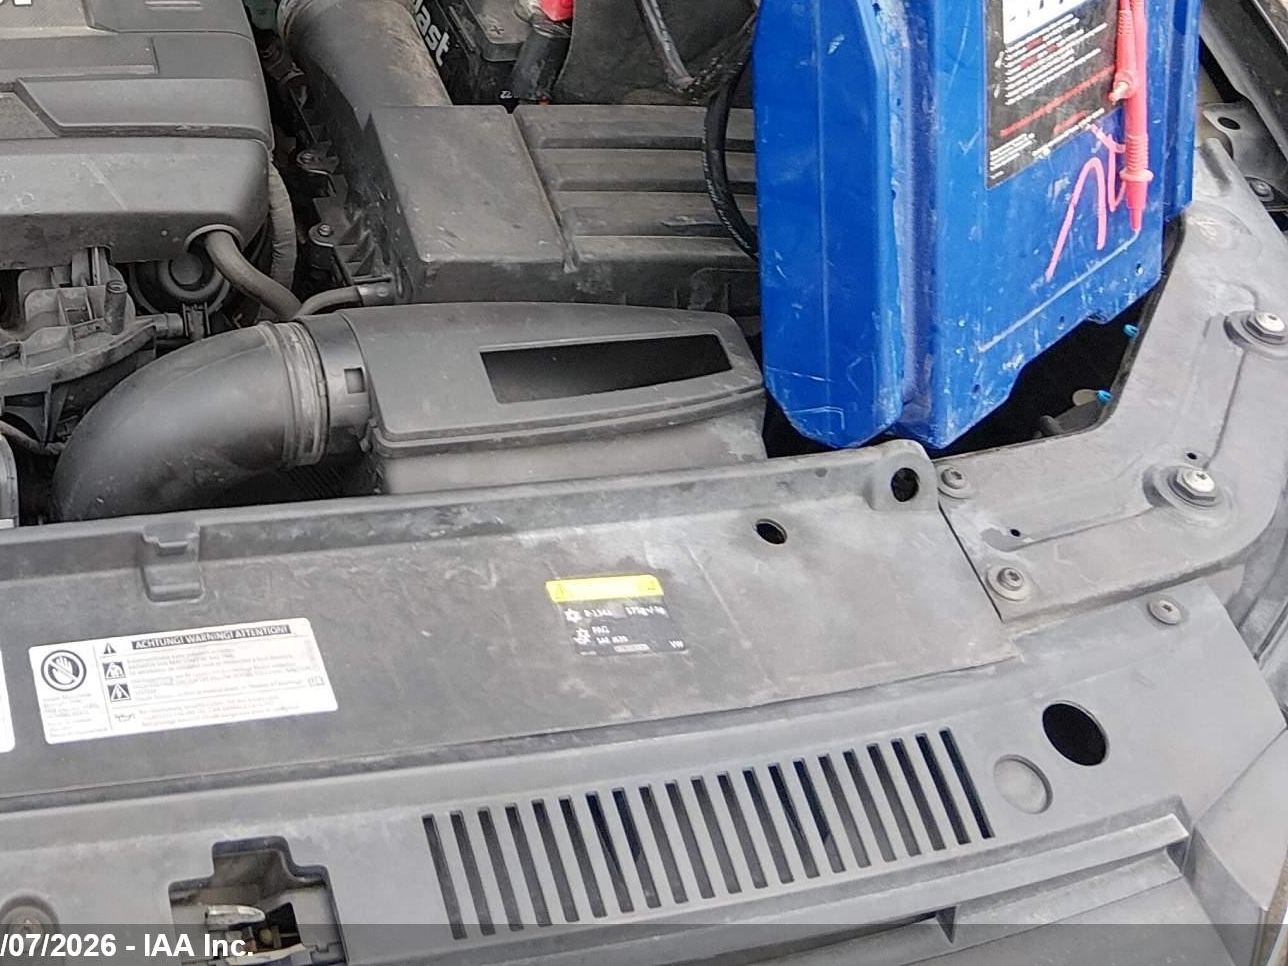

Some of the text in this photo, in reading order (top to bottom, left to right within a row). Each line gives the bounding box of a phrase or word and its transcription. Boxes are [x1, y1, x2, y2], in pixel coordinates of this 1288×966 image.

[134, 624, 287, 648] ACHTUNG! WARNING! ATTENTION!
